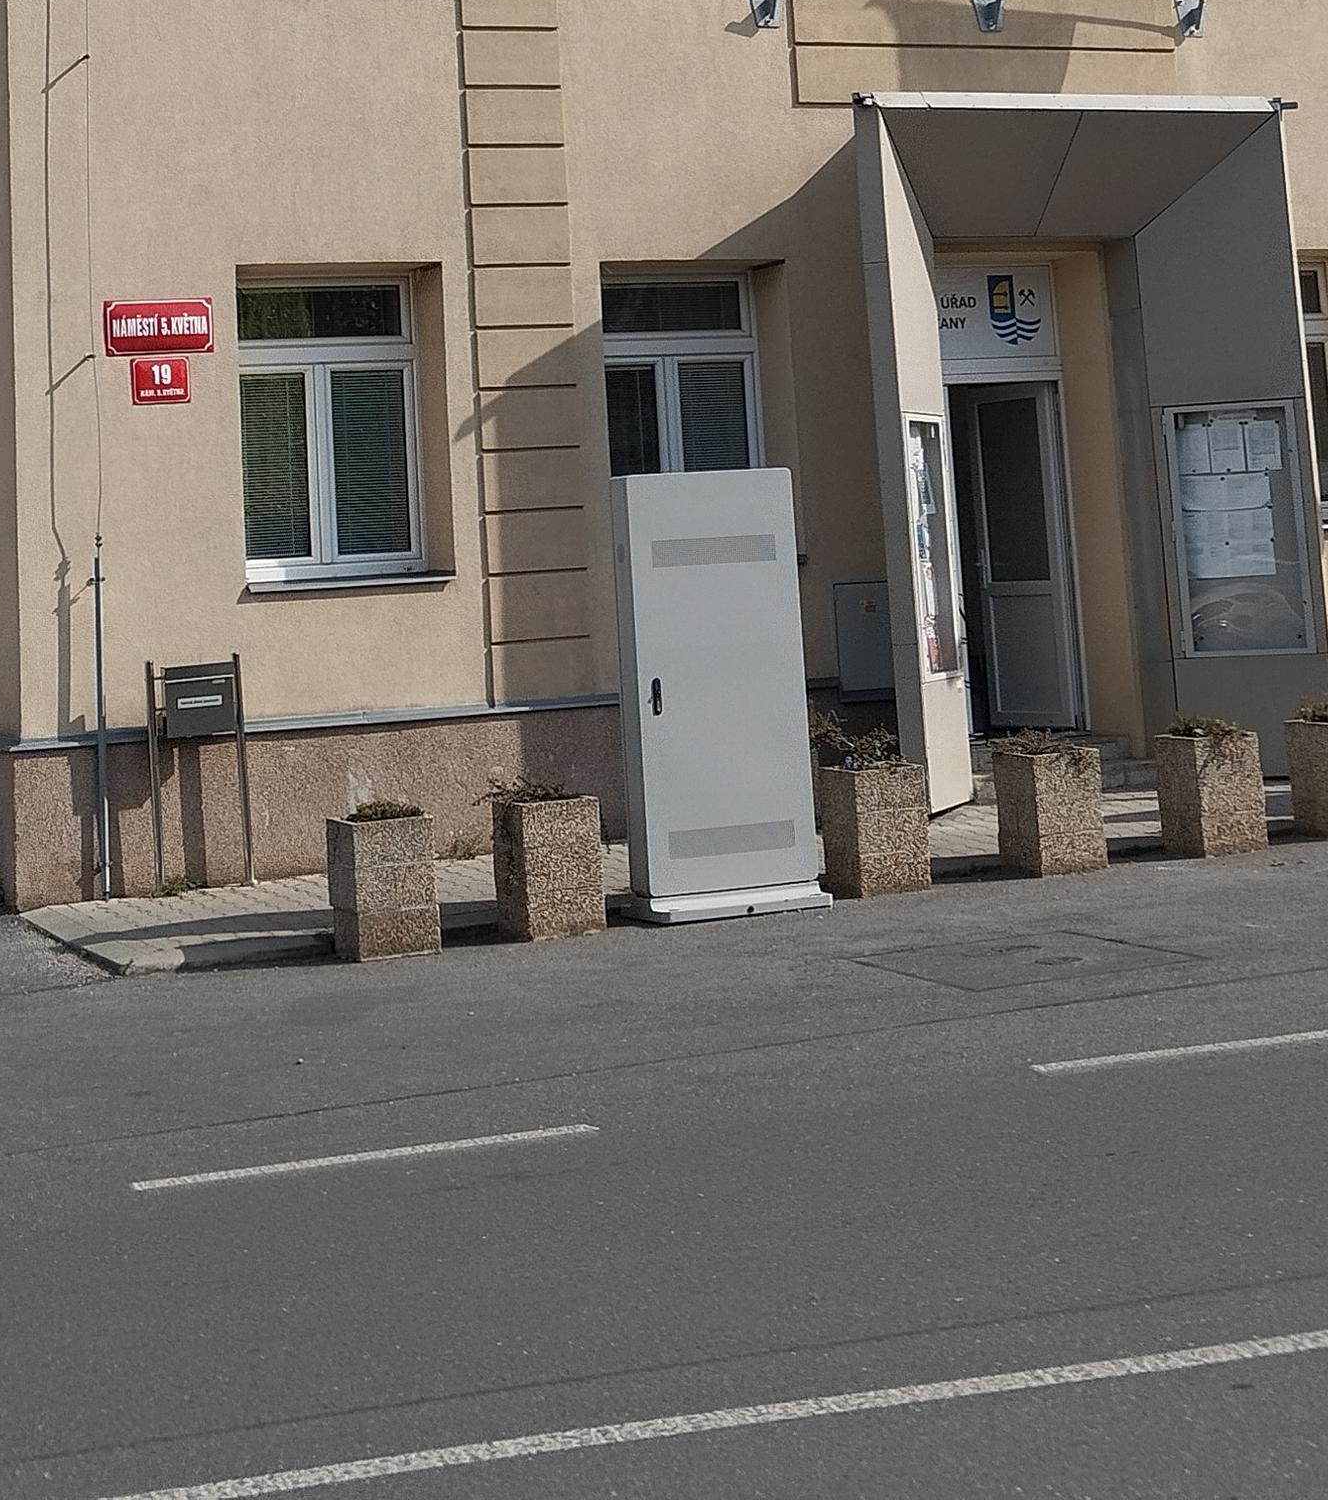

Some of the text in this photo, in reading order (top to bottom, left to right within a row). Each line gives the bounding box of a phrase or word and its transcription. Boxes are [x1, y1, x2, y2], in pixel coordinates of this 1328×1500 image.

[940, 294, 977, 308] ÚŘAD
[112, 313, 158, 338] NÁMĚSTÍ
[151, 363, 172, 385] 19
